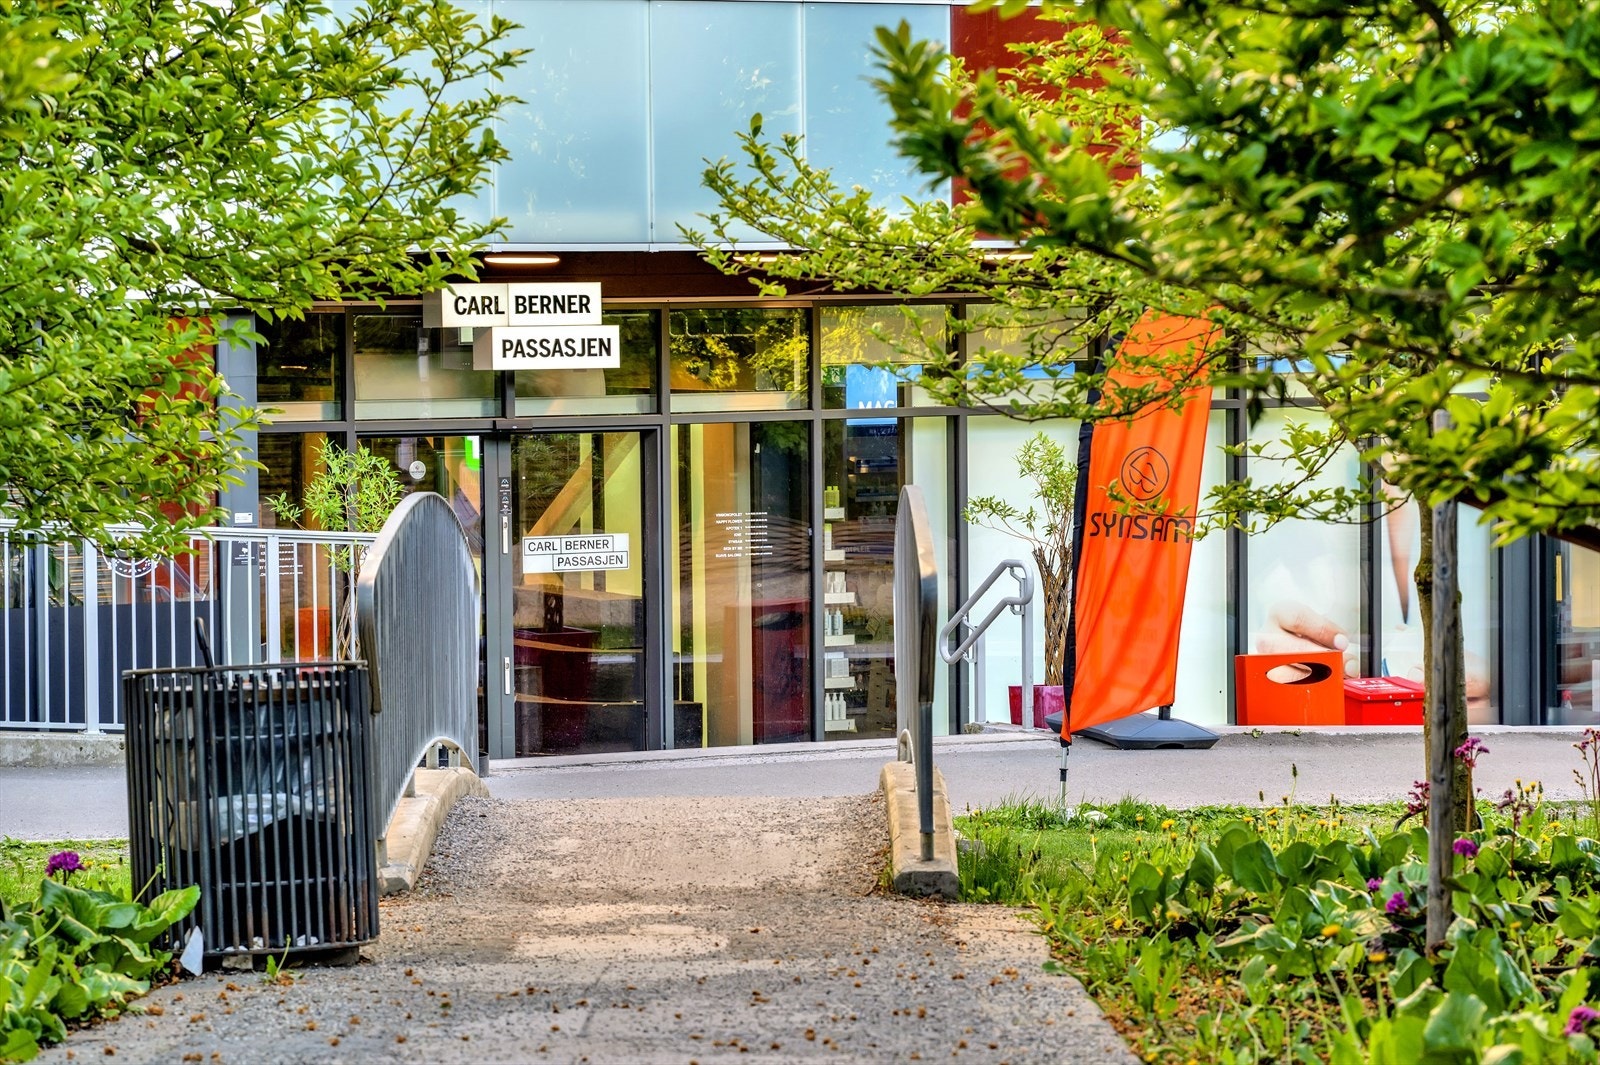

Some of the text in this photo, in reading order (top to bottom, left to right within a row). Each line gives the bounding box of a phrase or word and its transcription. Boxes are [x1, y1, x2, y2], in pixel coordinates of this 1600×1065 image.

[454, 294, 591, 315] CARL BERNER
[501, 337, 612, 358] PASSASJEN
[1090, 512, 1192, 543] SYNSAM
[528, 539, 609, 552] CARL BERNER
[557, 555, 623, 567] PASSASJEN
